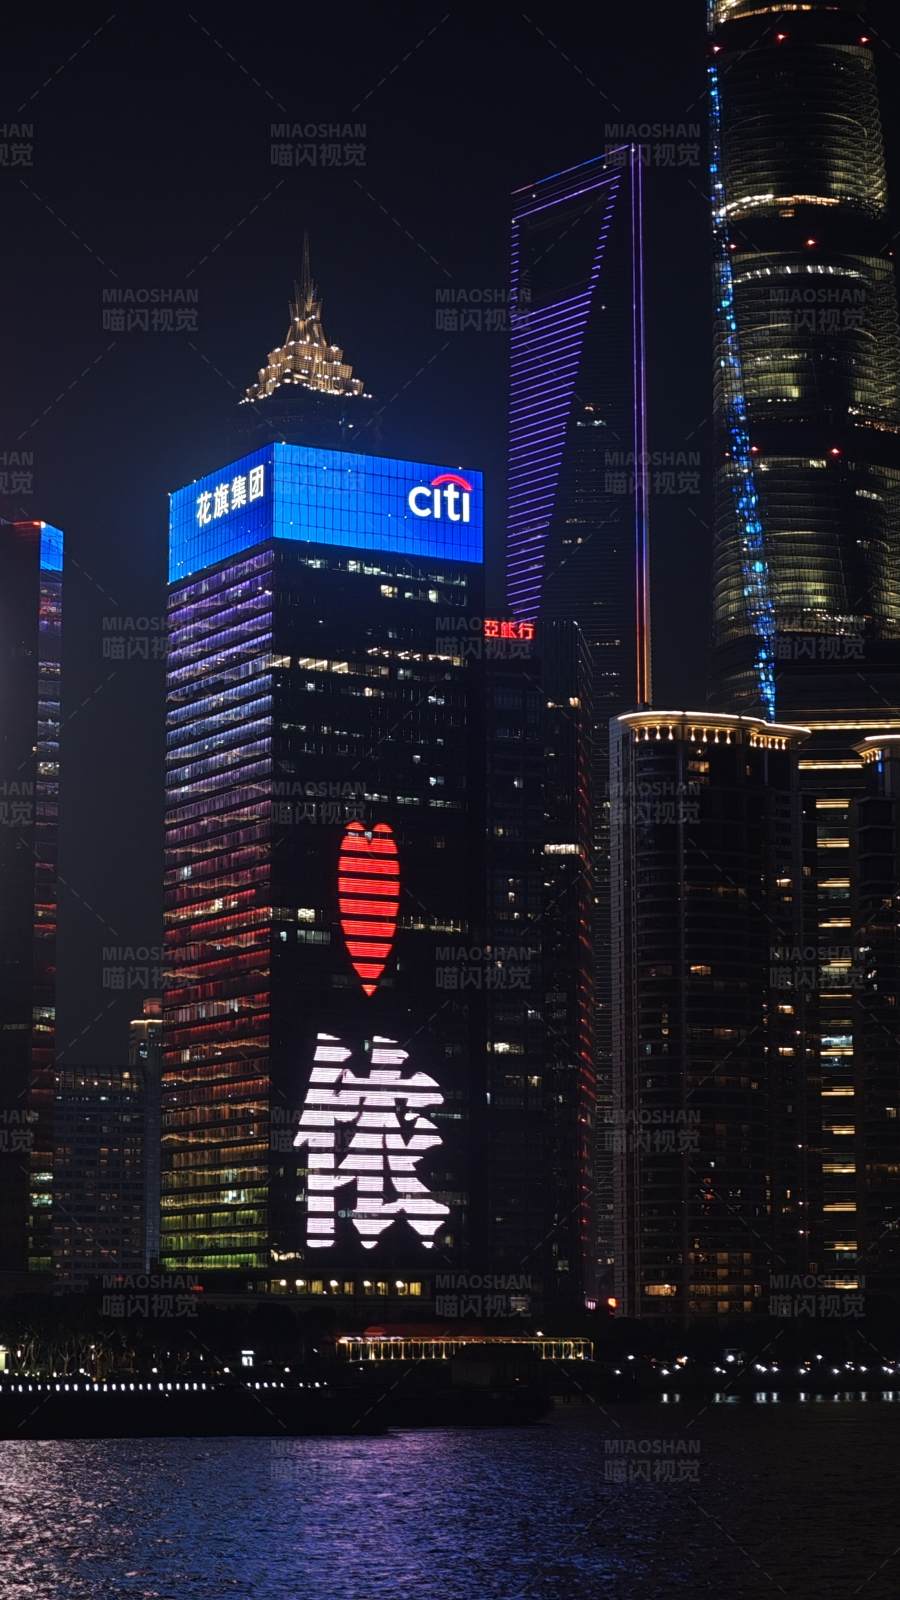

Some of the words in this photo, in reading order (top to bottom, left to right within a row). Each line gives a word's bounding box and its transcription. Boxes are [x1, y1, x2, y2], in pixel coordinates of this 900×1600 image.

[196, 464, 264, 528] 花旗集团
[408, 483, 470, 523] citi
